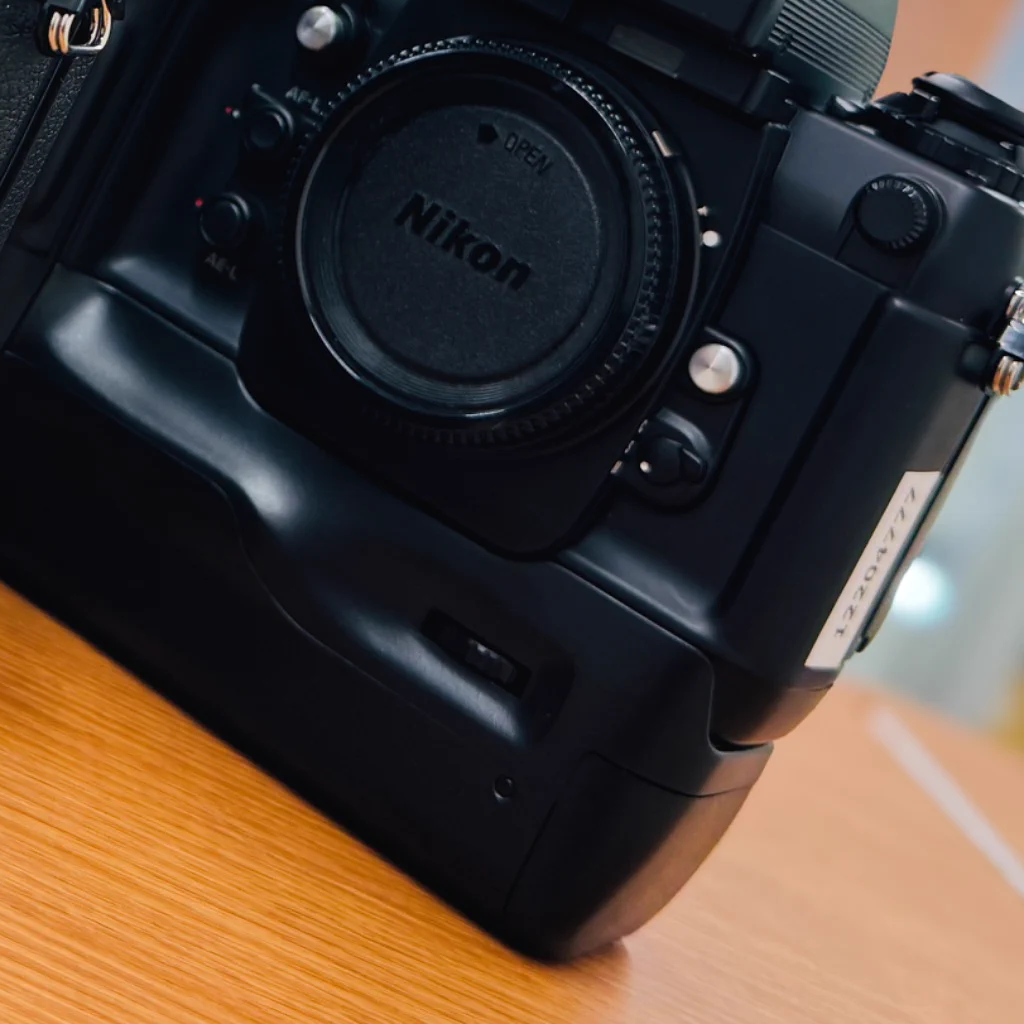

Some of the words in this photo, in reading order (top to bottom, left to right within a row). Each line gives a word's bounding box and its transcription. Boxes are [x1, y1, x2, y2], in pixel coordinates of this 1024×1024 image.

[504, 132, 553, 175] OPEN
[394, 193, 531, 291] Nikon
[833, 487, 916, 638] 12204777
